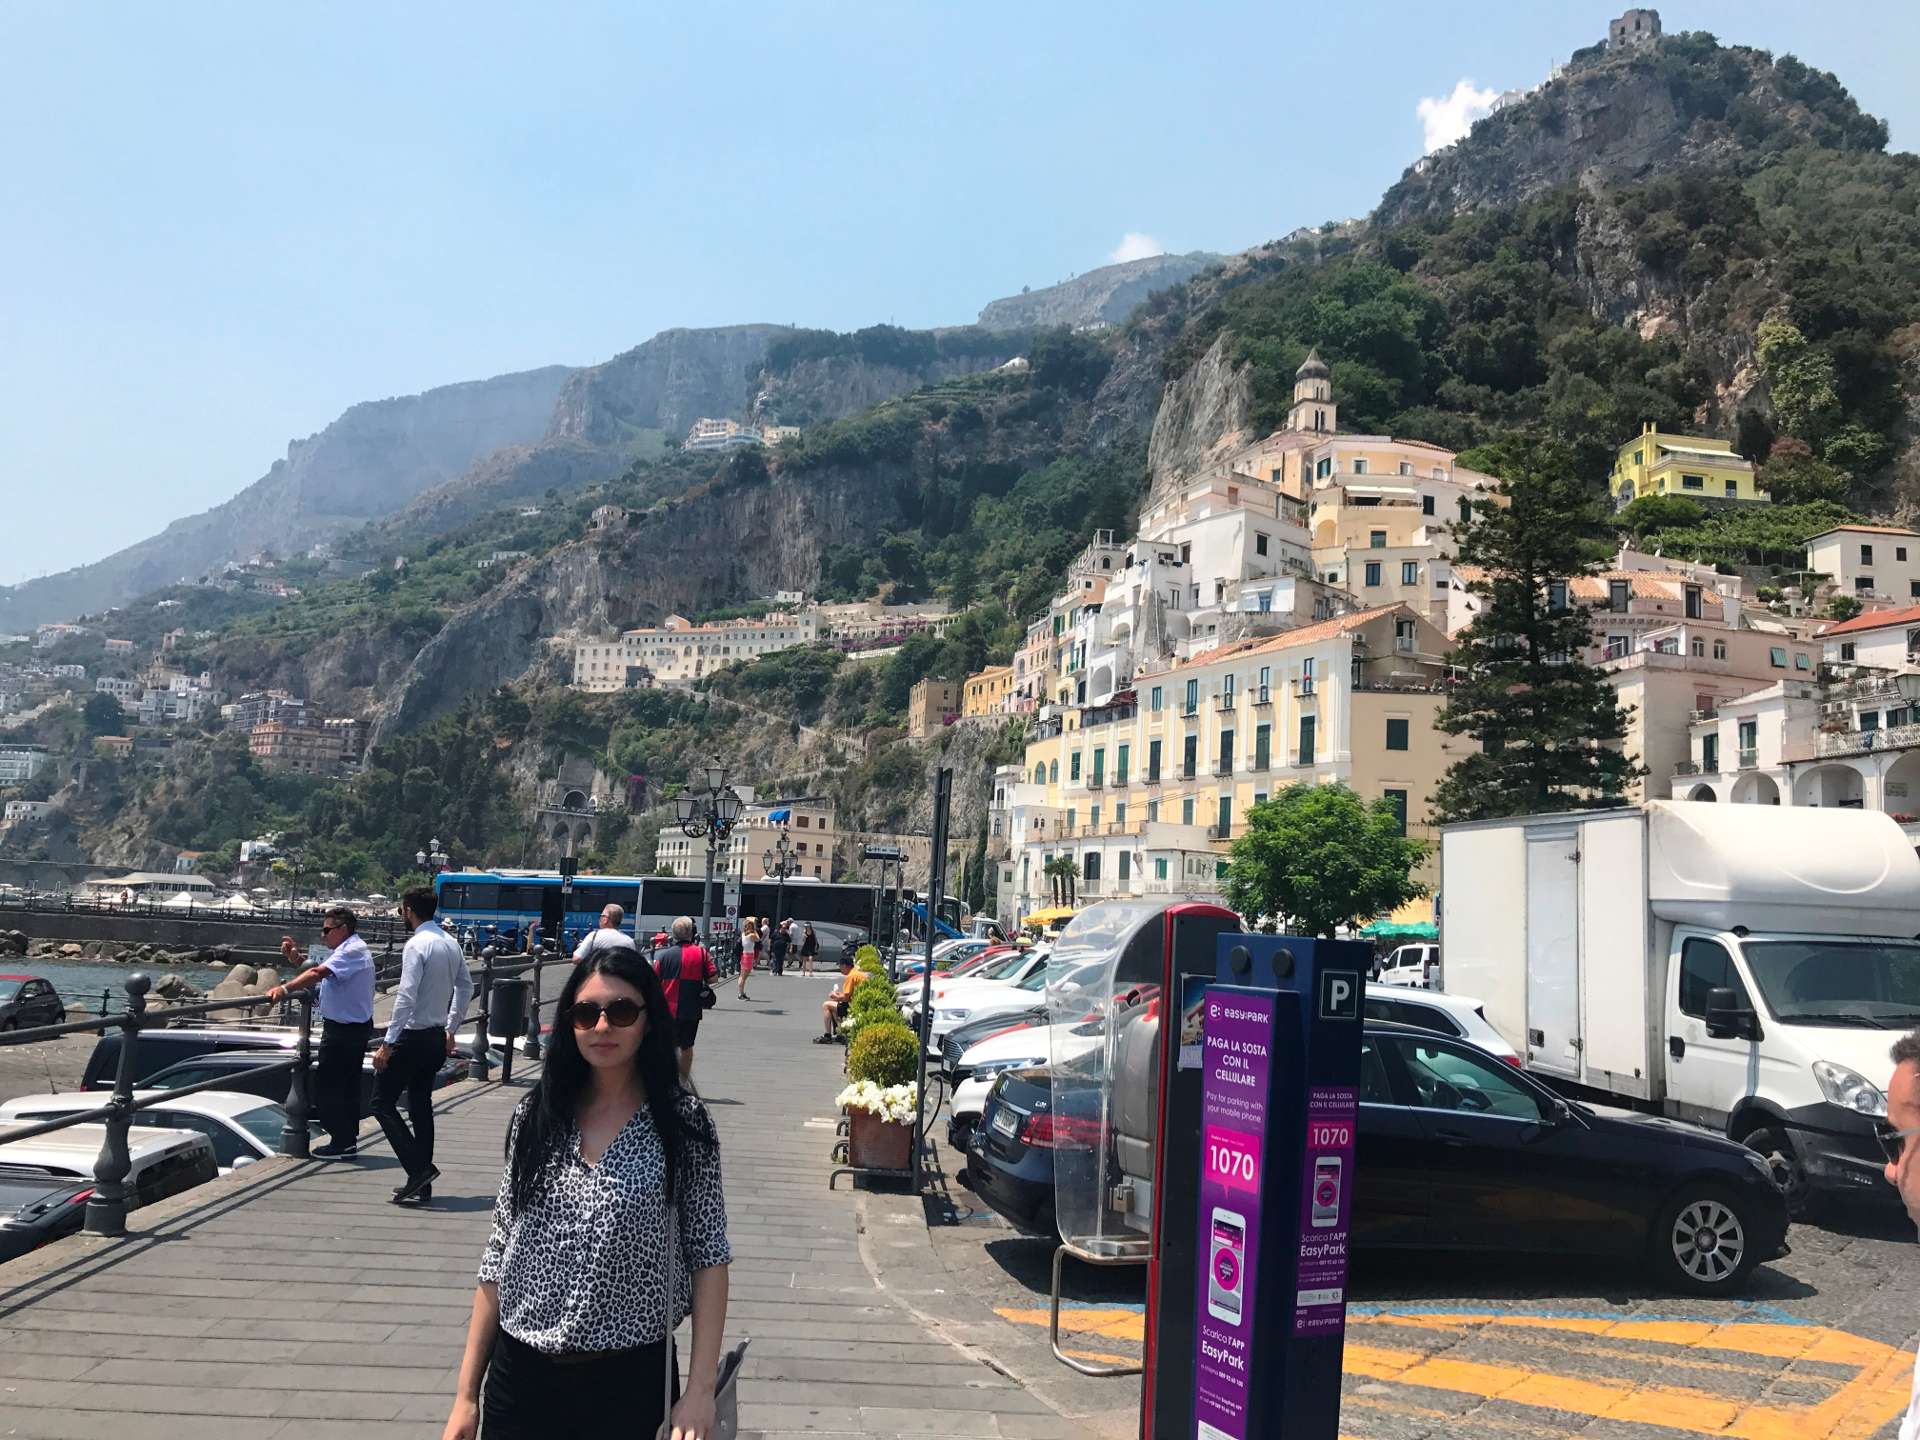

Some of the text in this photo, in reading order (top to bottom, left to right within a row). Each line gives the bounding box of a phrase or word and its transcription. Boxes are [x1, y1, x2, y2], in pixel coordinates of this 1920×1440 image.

[1331, 980, 1350, 1011] P
[1207, 1036, 1230, 1050] PAGA
[1231, 1041, 1240, 1052] LA
[1242, 1042, 1267, 1057] SOSTA
[1222, 1054, 1249, 1070] CON IL
[1215, 1069, 1256, 1087] CELLULARE
[1206, 1090, 1263, 1111] Pay for parking with
[1207, 1104, 1219, 1113] your
[1220, 1107, 1241, 1118] mobile
[1313, 1128, 1349, 1145] 1070
[1210, 1145, 1254, 1181] 1070
[1301, 1234, 1328, 1243] Scarica
[1300, 1243, 1346, 1258] EasyPark
[1202, 1325, 1227, 1344] Scarica
[1202, 1340, 1244, 1371] EasyPark
